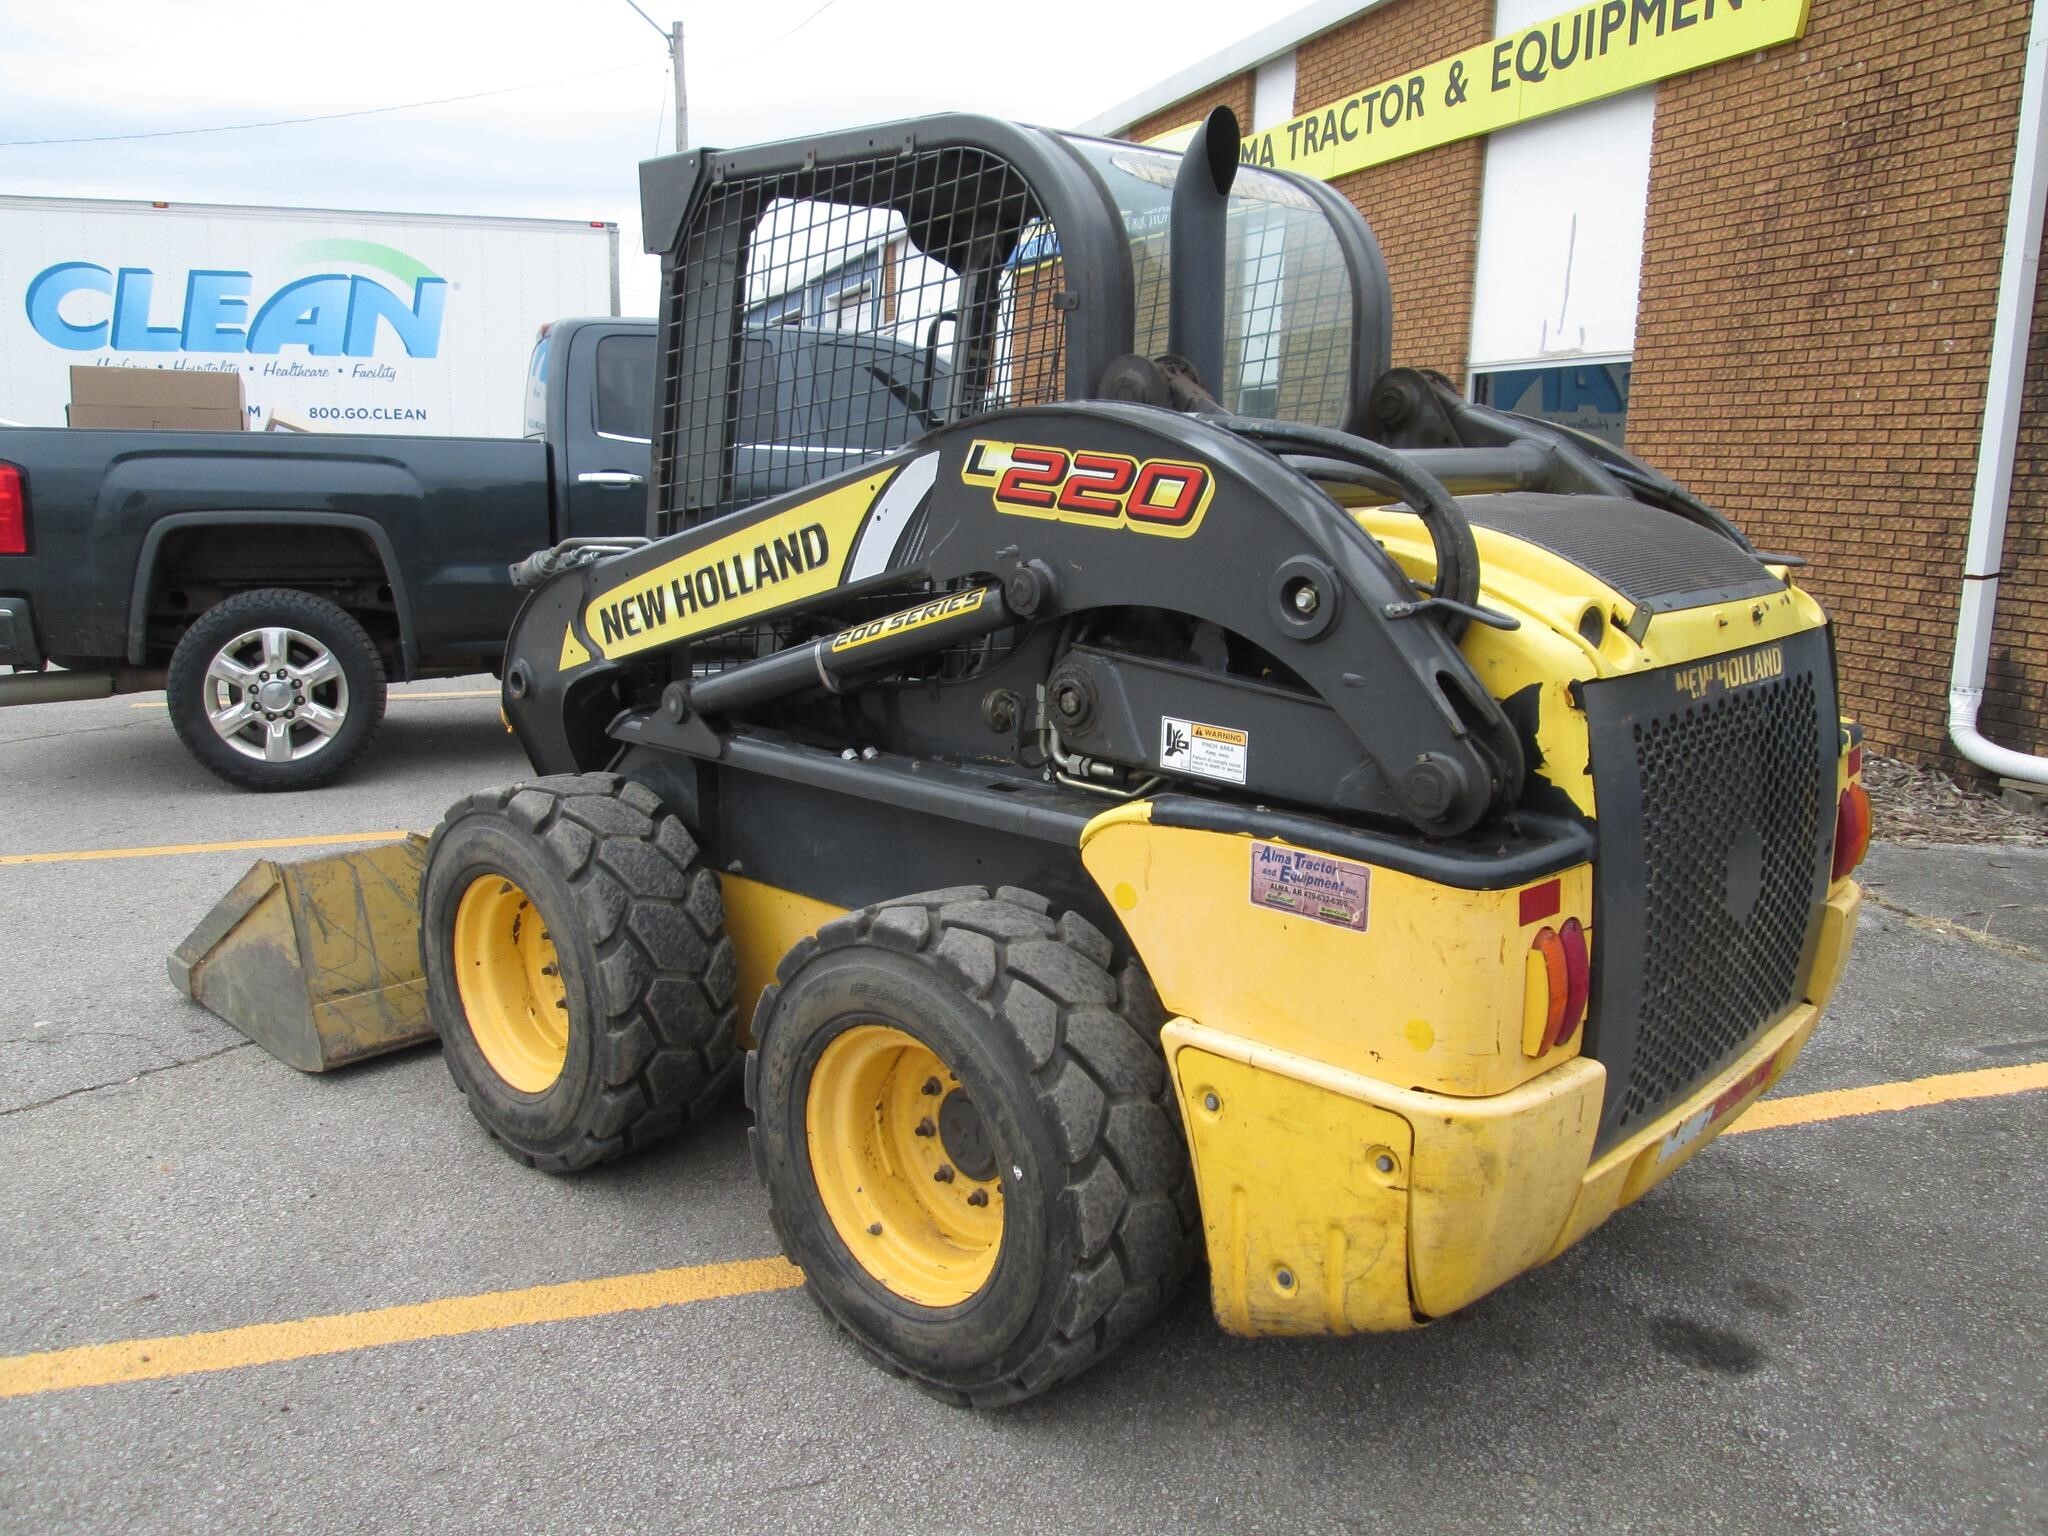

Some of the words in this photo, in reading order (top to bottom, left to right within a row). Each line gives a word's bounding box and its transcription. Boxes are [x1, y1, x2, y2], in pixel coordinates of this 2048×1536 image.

[1241, 133, 1275, 168] MA
[1287, 75, 1425, 160] TRACTOR
[1444, 60, 1468, 107] &
[1491, 0, 1765, 92] EQUIPME
[25, 261, 447, 359] CLEAN
[264, 361, 330, 377] Healthcare
[352, 364, 397, 382] Facility
[309, 407, 427, 420] 800.GO.CLEAN
[600, 584, 667, 645] NEW
[671, 522, 829, 618] HOLLAND
[834, 618, 884, 647] 200
[888, 591, 984, 631] SERIES
[1717, 647, 1782, 689] HOLLAND
[1204, 729, 1242, 742] WARNING
[1260, 846, 1292, 866] Alma
[1294, 852, 1339, 875] Tractor
[1262, 868, 1276, 877] and
[1279, 865, 1344, 891] Equipment
[1270, 883, 1290, 894] ALMA,
